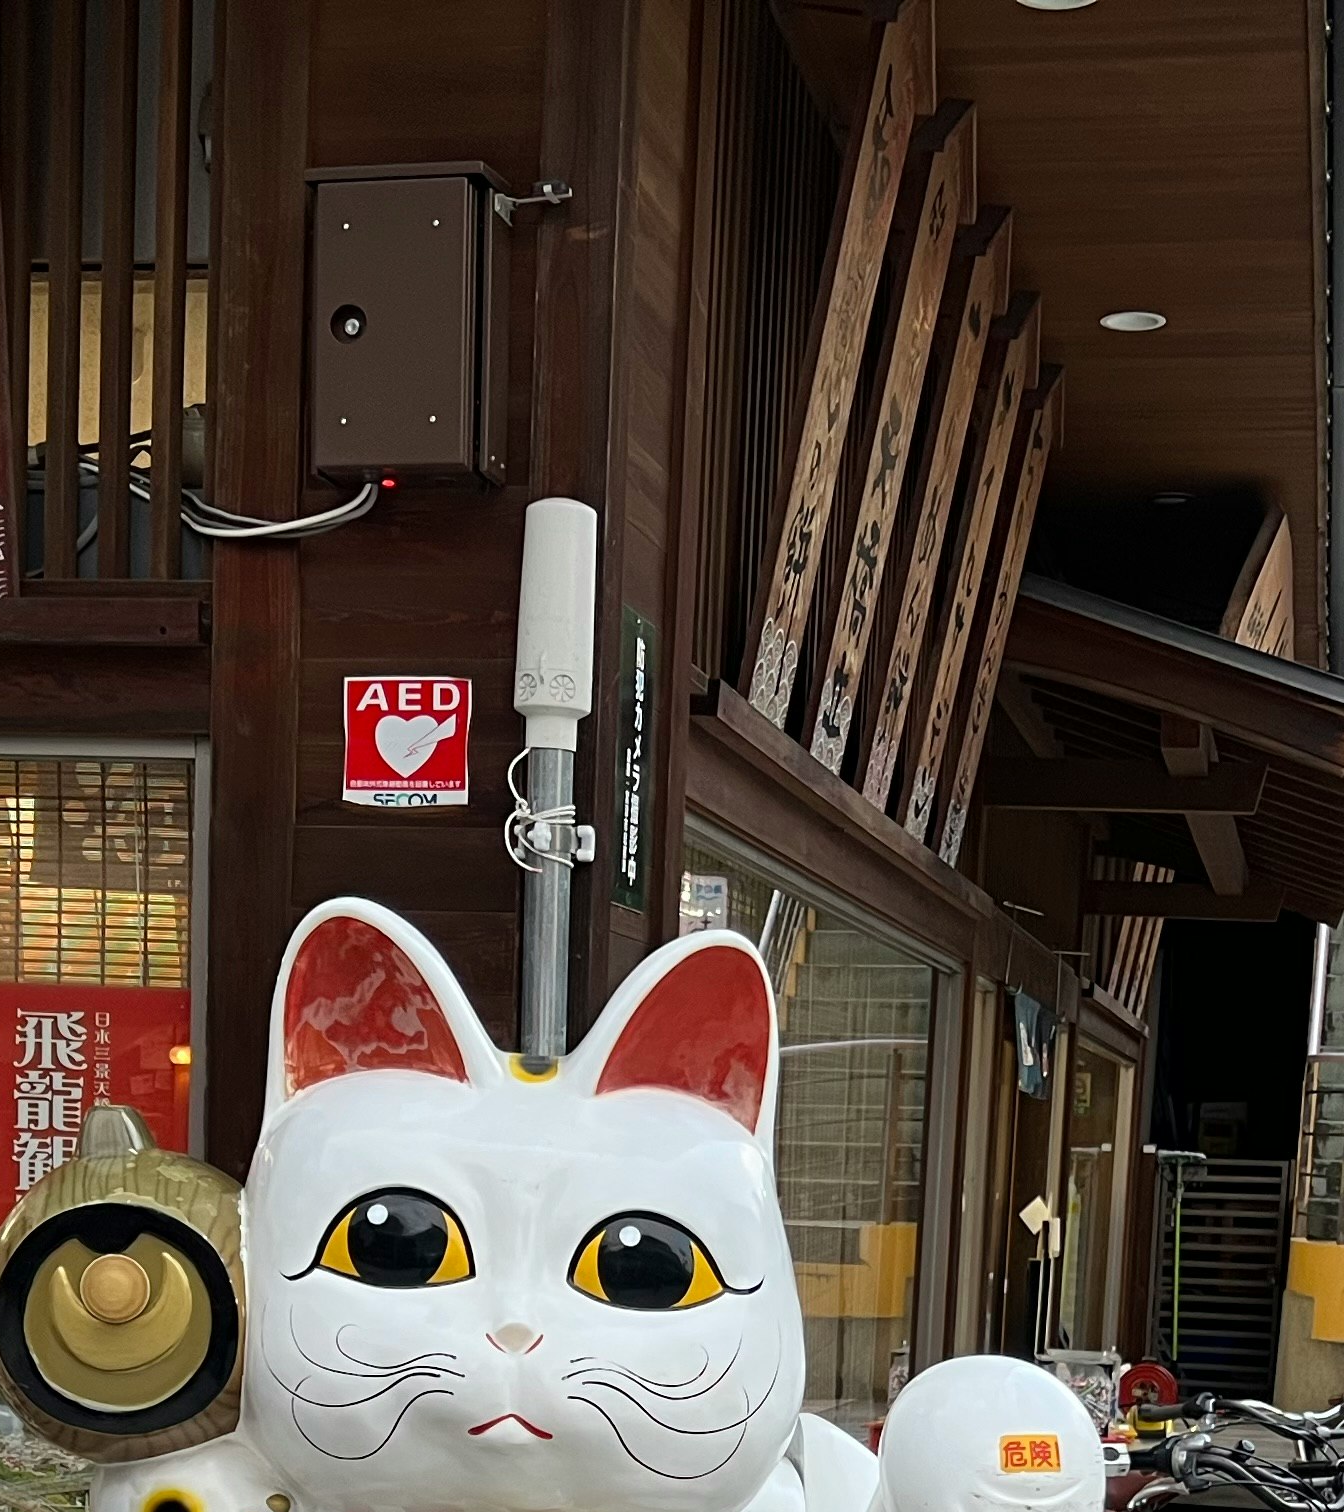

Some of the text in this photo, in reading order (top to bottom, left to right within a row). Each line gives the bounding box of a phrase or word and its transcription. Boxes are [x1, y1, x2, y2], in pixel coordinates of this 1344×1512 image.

[356, 683, 461, 711] AED
[373, 793, 438, 805] SECOM
[13, 1007, 89, 1202] 飛龍観
[1003, 1440, 1061, 1468] 危険!
